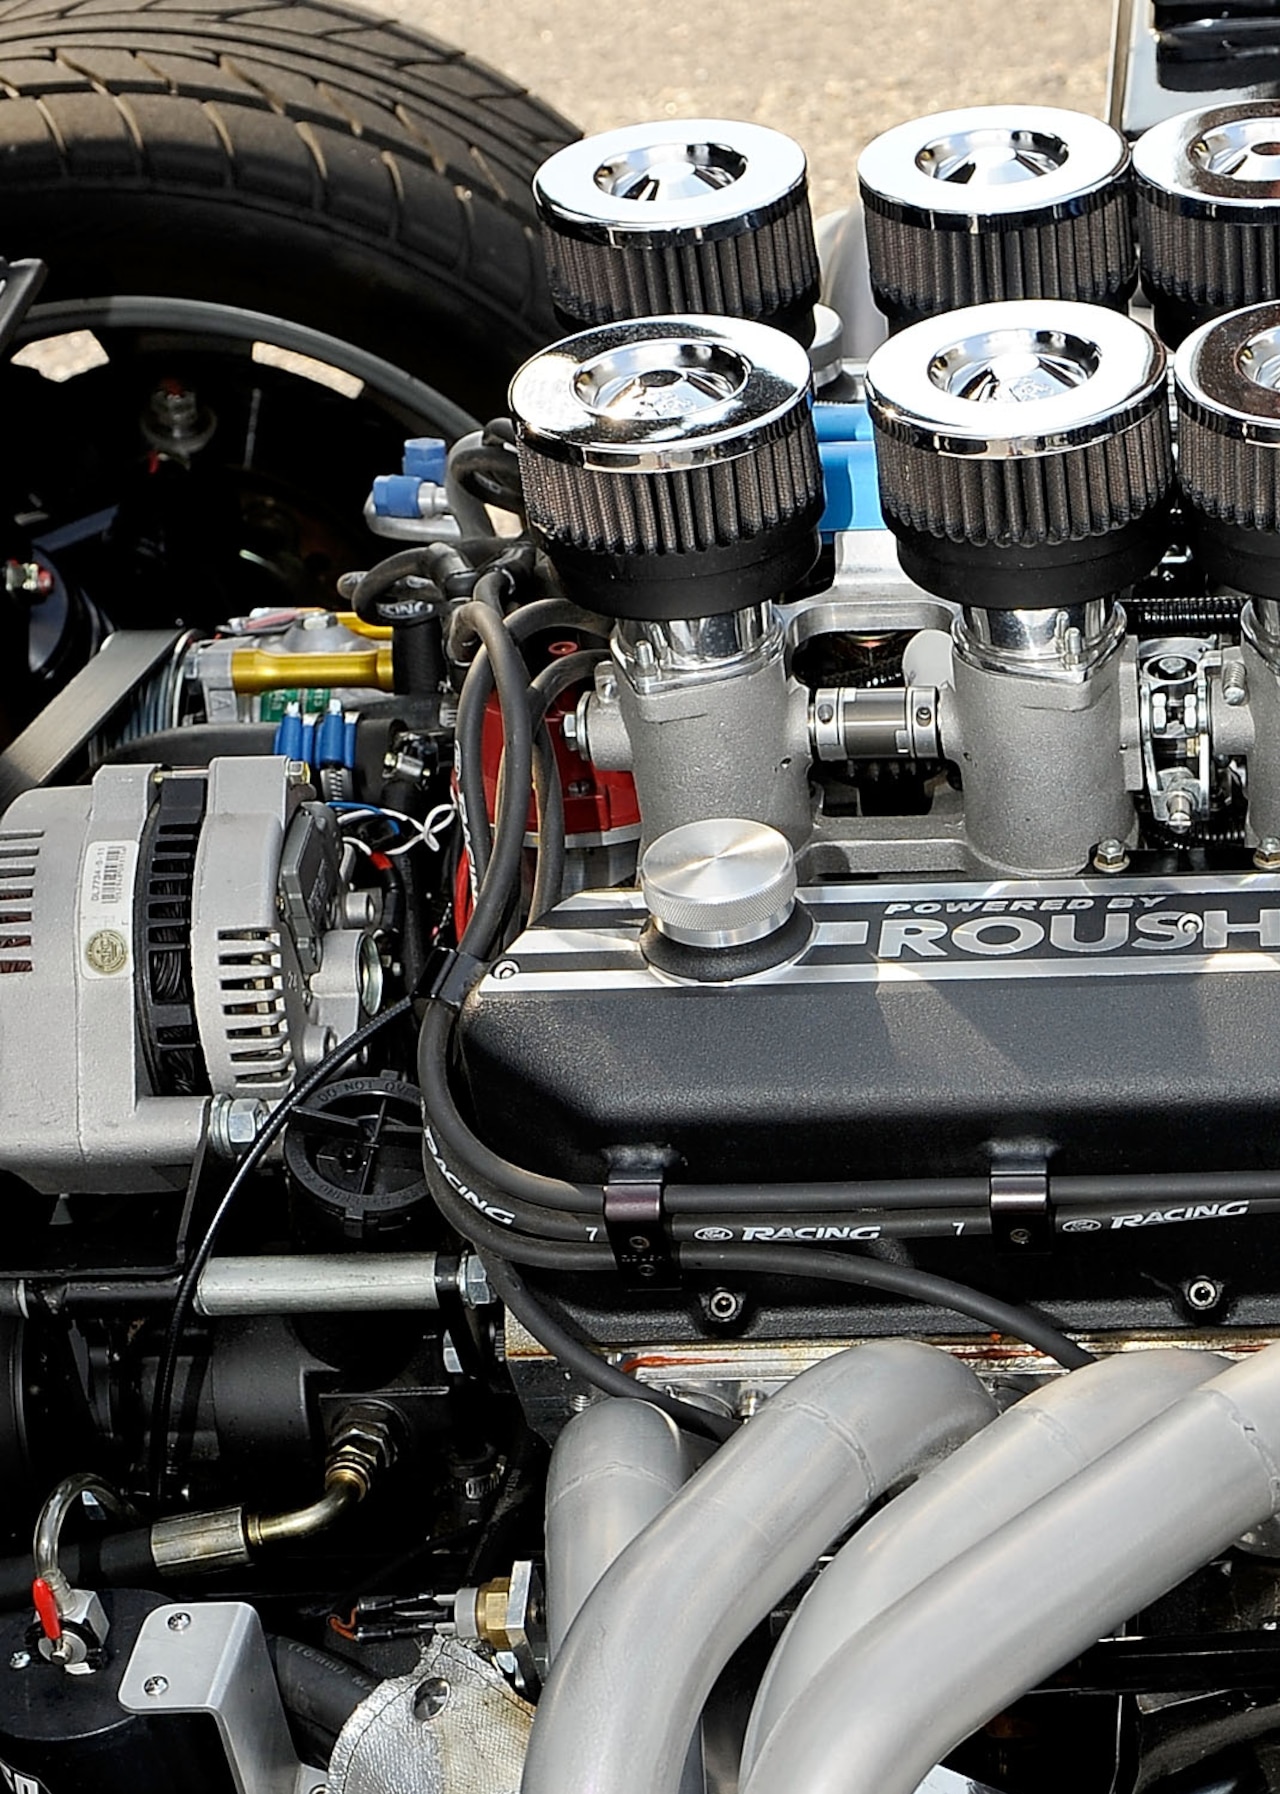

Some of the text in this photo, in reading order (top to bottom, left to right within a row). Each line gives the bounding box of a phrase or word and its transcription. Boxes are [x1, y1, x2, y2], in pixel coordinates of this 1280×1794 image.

[884, 896, 1167, 915] POWERED BY
[1110, 1200, 1250, 1229] RACING
[585, 1226, 599, 1242] 7
[741, 1226, 881, 1241] RACING
[952, 1222, 965, 1236] 7
